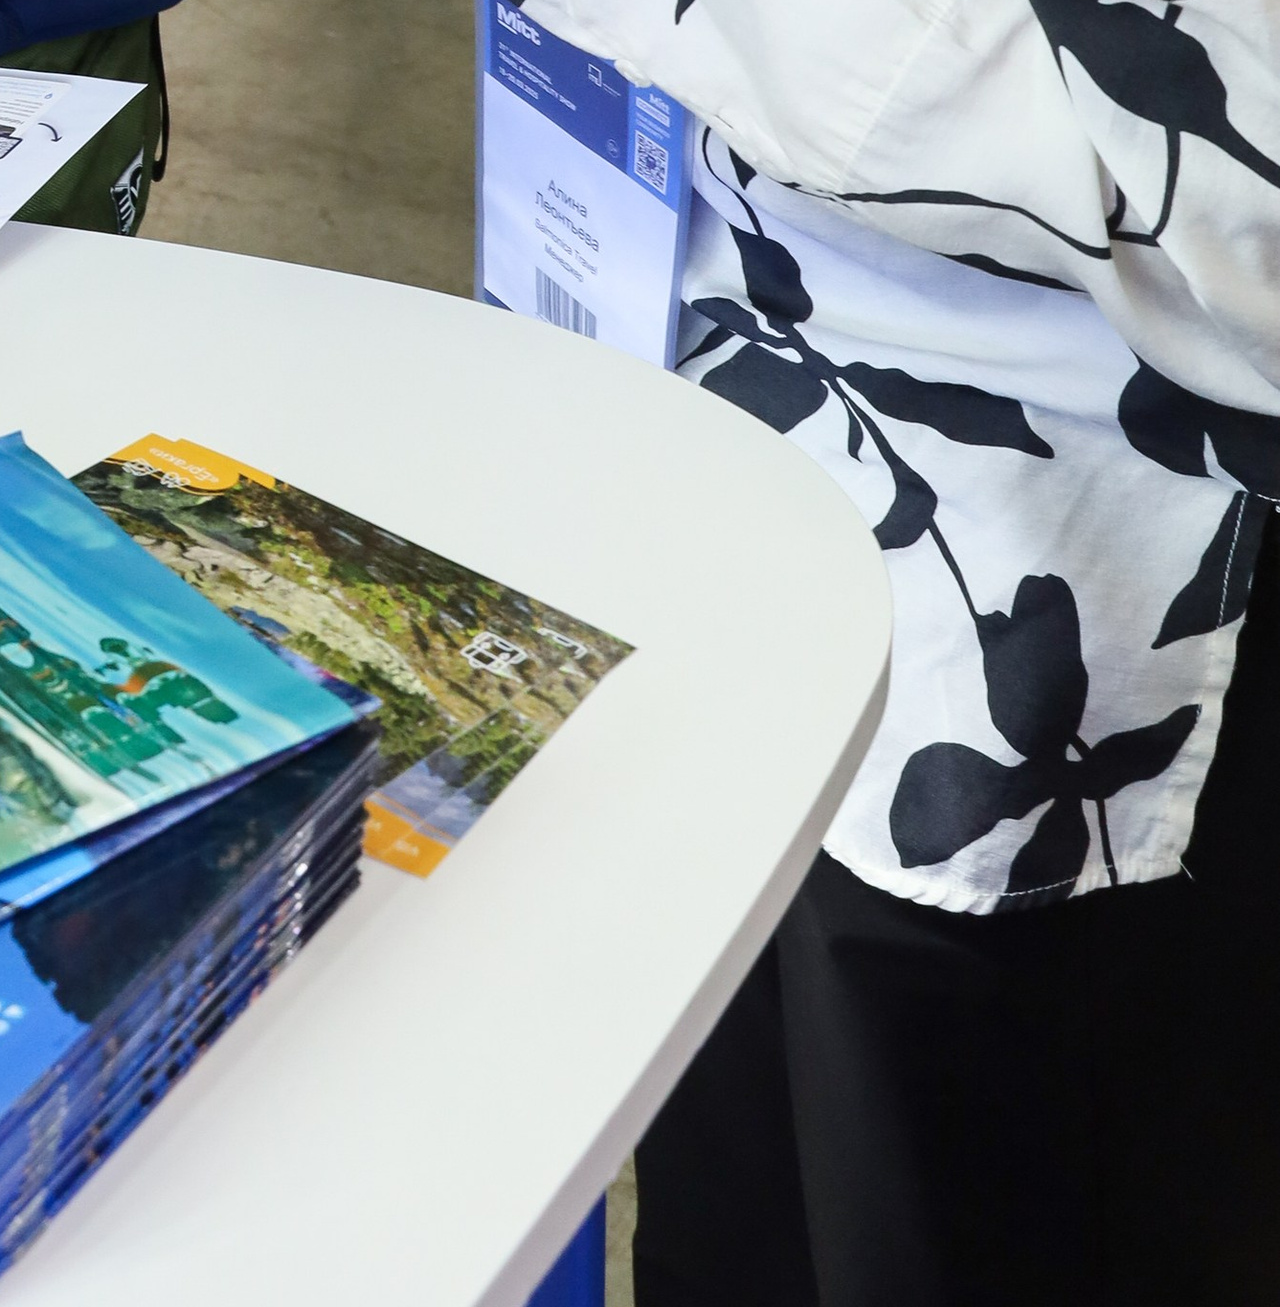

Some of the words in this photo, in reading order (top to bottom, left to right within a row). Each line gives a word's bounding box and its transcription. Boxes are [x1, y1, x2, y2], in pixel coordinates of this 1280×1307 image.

[496, 2, 541, 46] Mitt
[547, 179, 587, 218] Алина
[535, 191, 600, 253] Леонтьева
